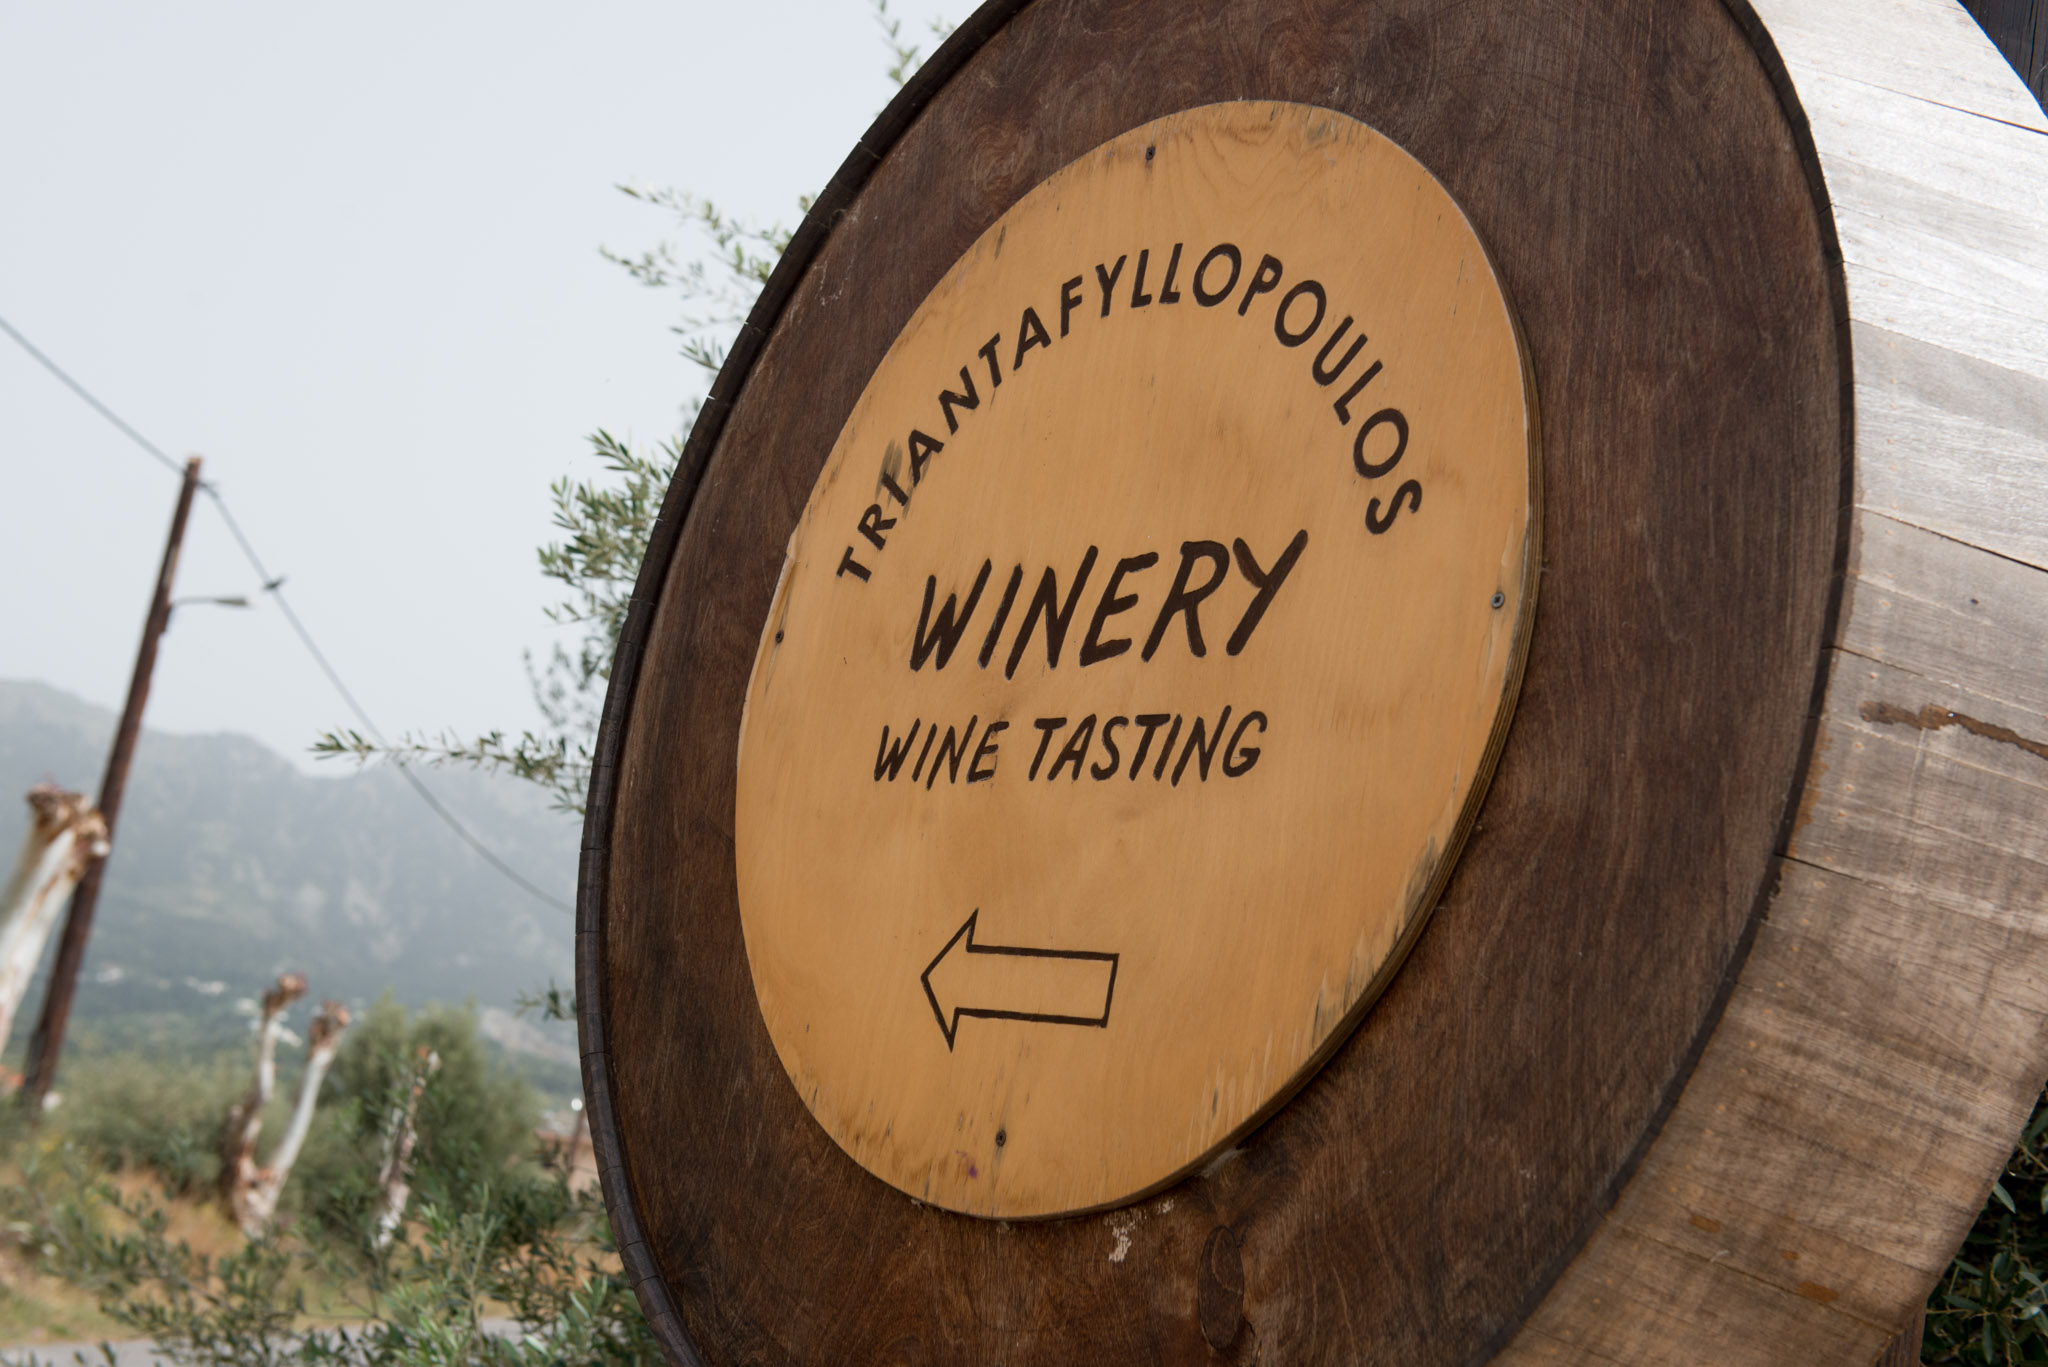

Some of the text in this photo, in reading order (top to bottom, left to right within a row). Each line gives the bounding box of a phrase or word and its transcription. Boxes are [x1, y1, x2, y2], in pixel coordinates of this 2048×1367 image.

[837, 243, 1422, 583] TRIANTAFYLLOPOULOS
[910, 529, 1308, 680] WINERY
[874, 705, 1267, 790] WINE TASTING
